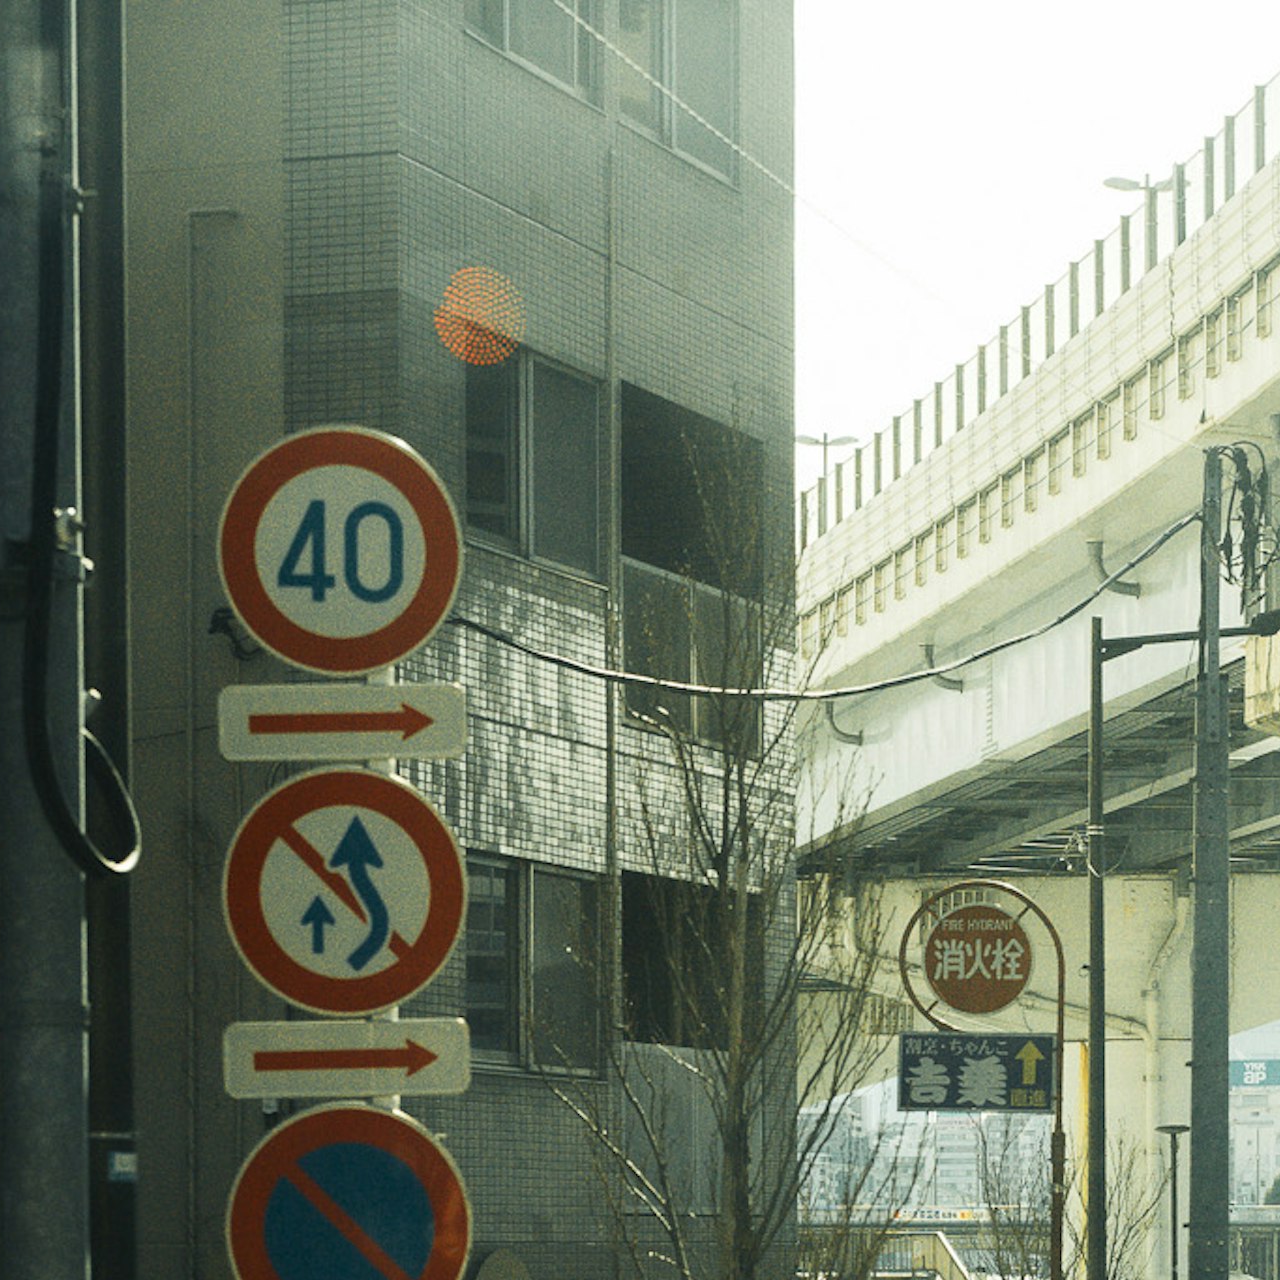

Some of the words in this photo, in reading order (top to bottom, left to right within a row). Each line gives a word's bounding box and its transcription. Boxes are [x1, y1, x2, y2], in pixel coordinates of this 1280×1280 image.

[277, 499, 404, 604] 40
[941, 918, 965, 932] FIRE
[967, 918, 1014, 932] HYDRANT
[932, 937, 1025, 982] 消火栓
